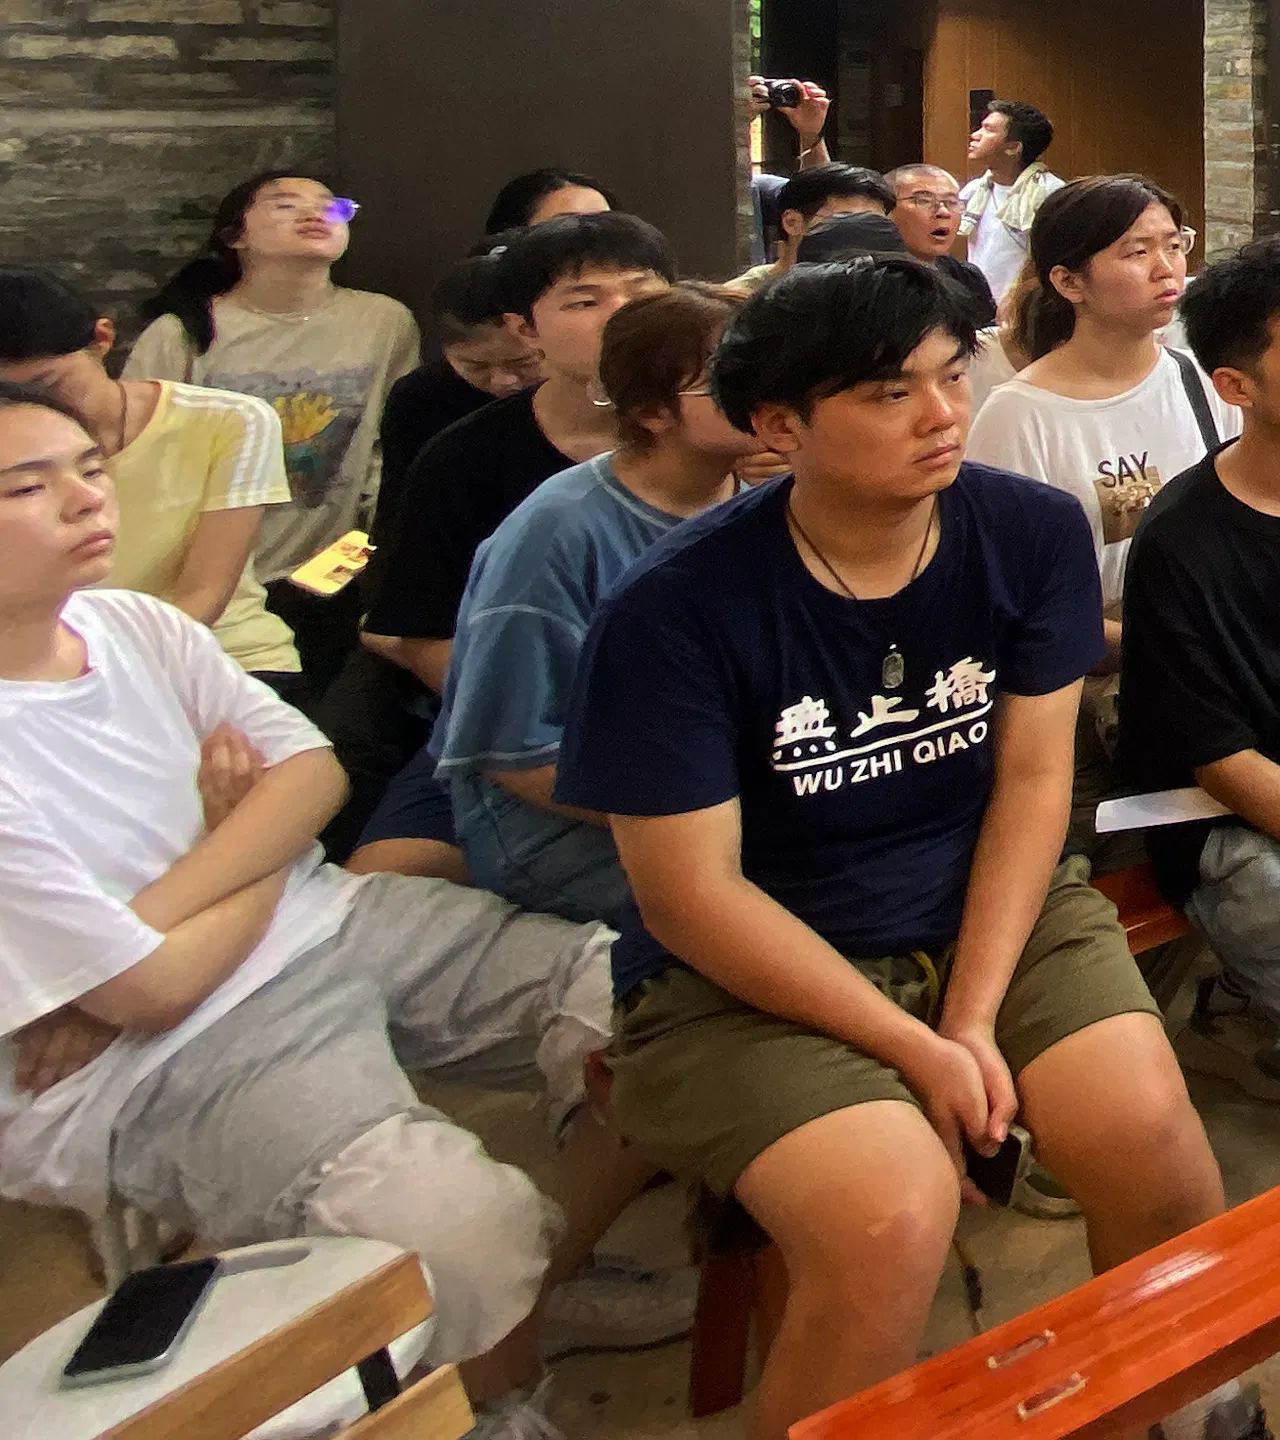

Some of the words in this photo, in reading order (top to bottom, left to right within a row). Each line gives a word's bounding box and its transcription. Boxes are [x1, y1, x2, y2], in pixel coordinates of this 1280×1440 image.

[1098, 451, 1148, 488] SAY
[793, 766, 843, 796] WU
[850, 749, 902, 783] ZHI
[913, 721, 988, 764] QIAO
